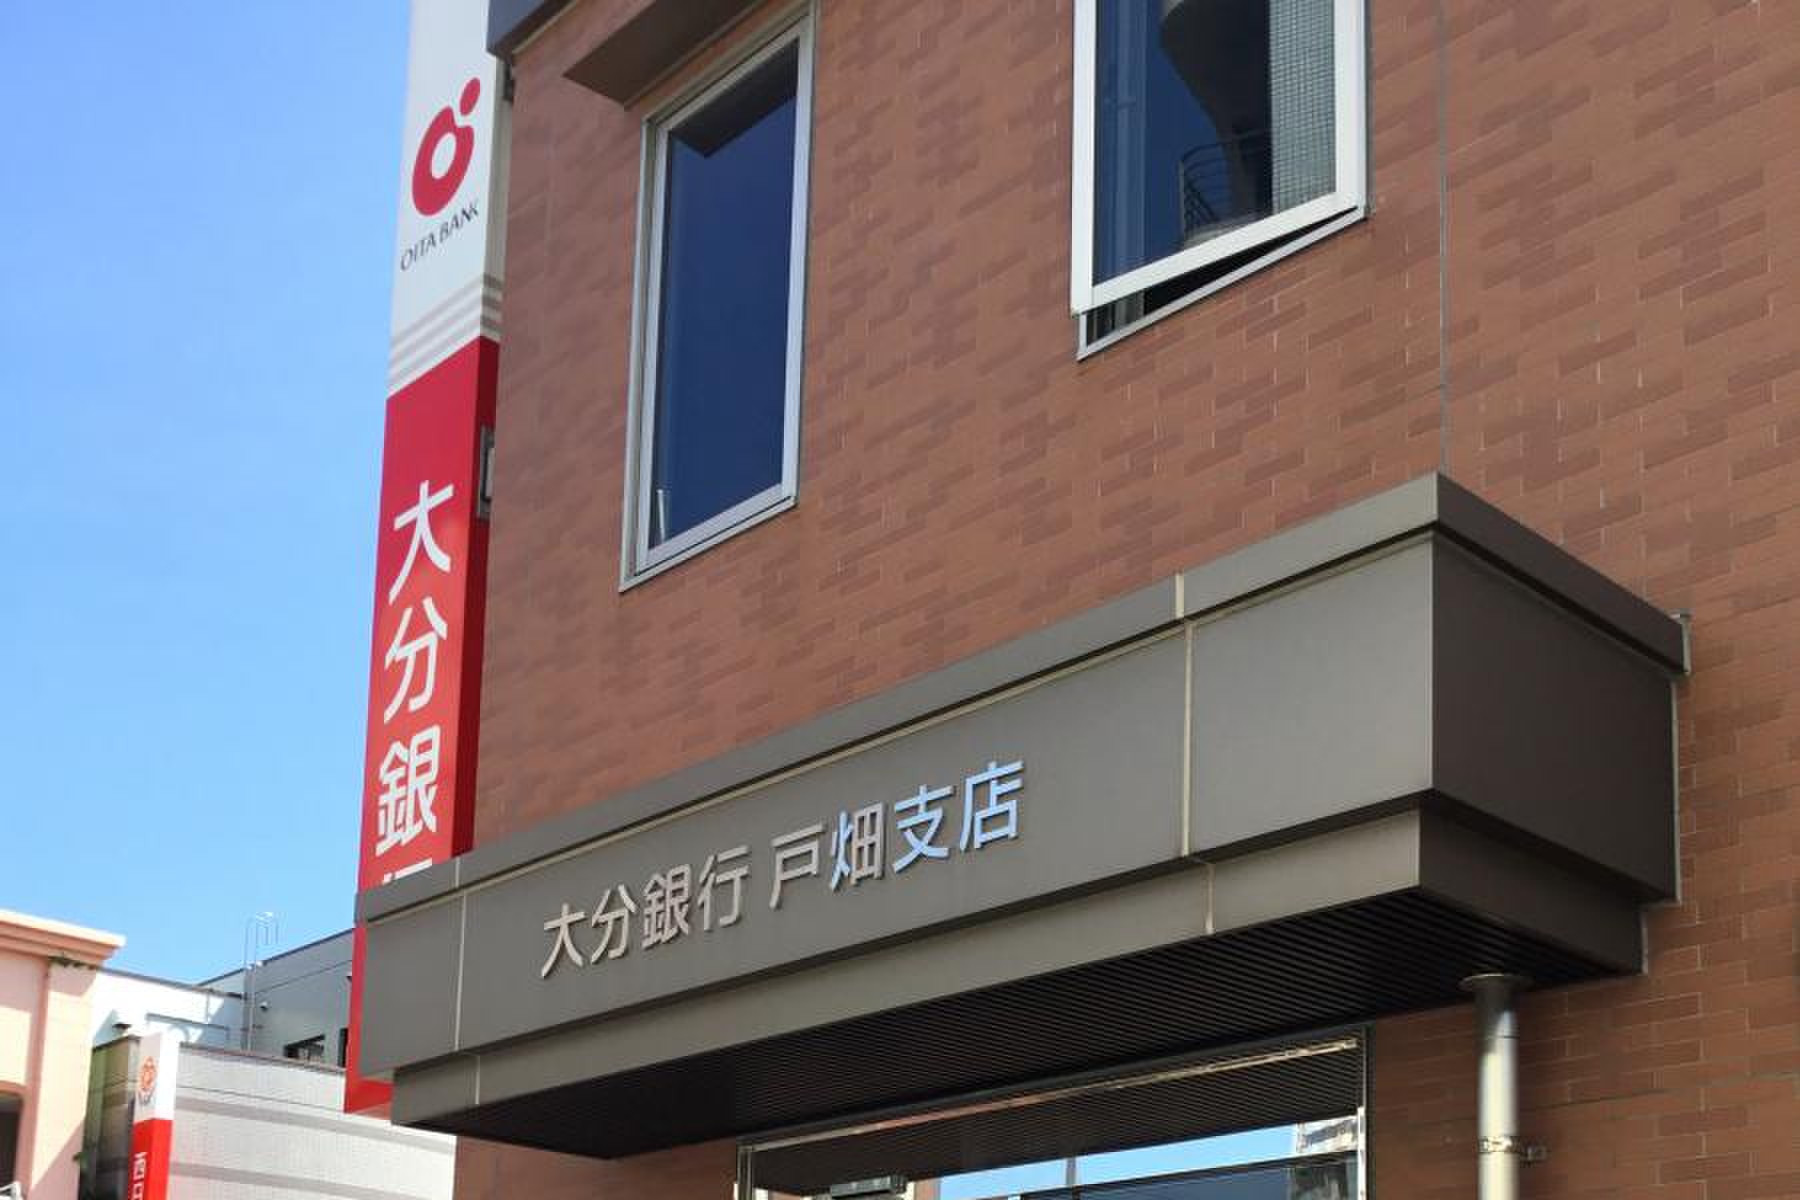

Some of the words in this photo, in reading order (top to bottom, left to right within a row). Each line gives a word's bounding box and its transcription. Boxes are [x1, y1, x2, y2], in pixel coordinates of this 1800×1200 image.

[400, 232, 436, 271] OITA
[439, 200, 479, 242] BANK
[375, 479, 455, 883] 大分銀
[540, 844, 752, 979] 大分銀行
[768, 760, 1025, 910] 戸畑支店
